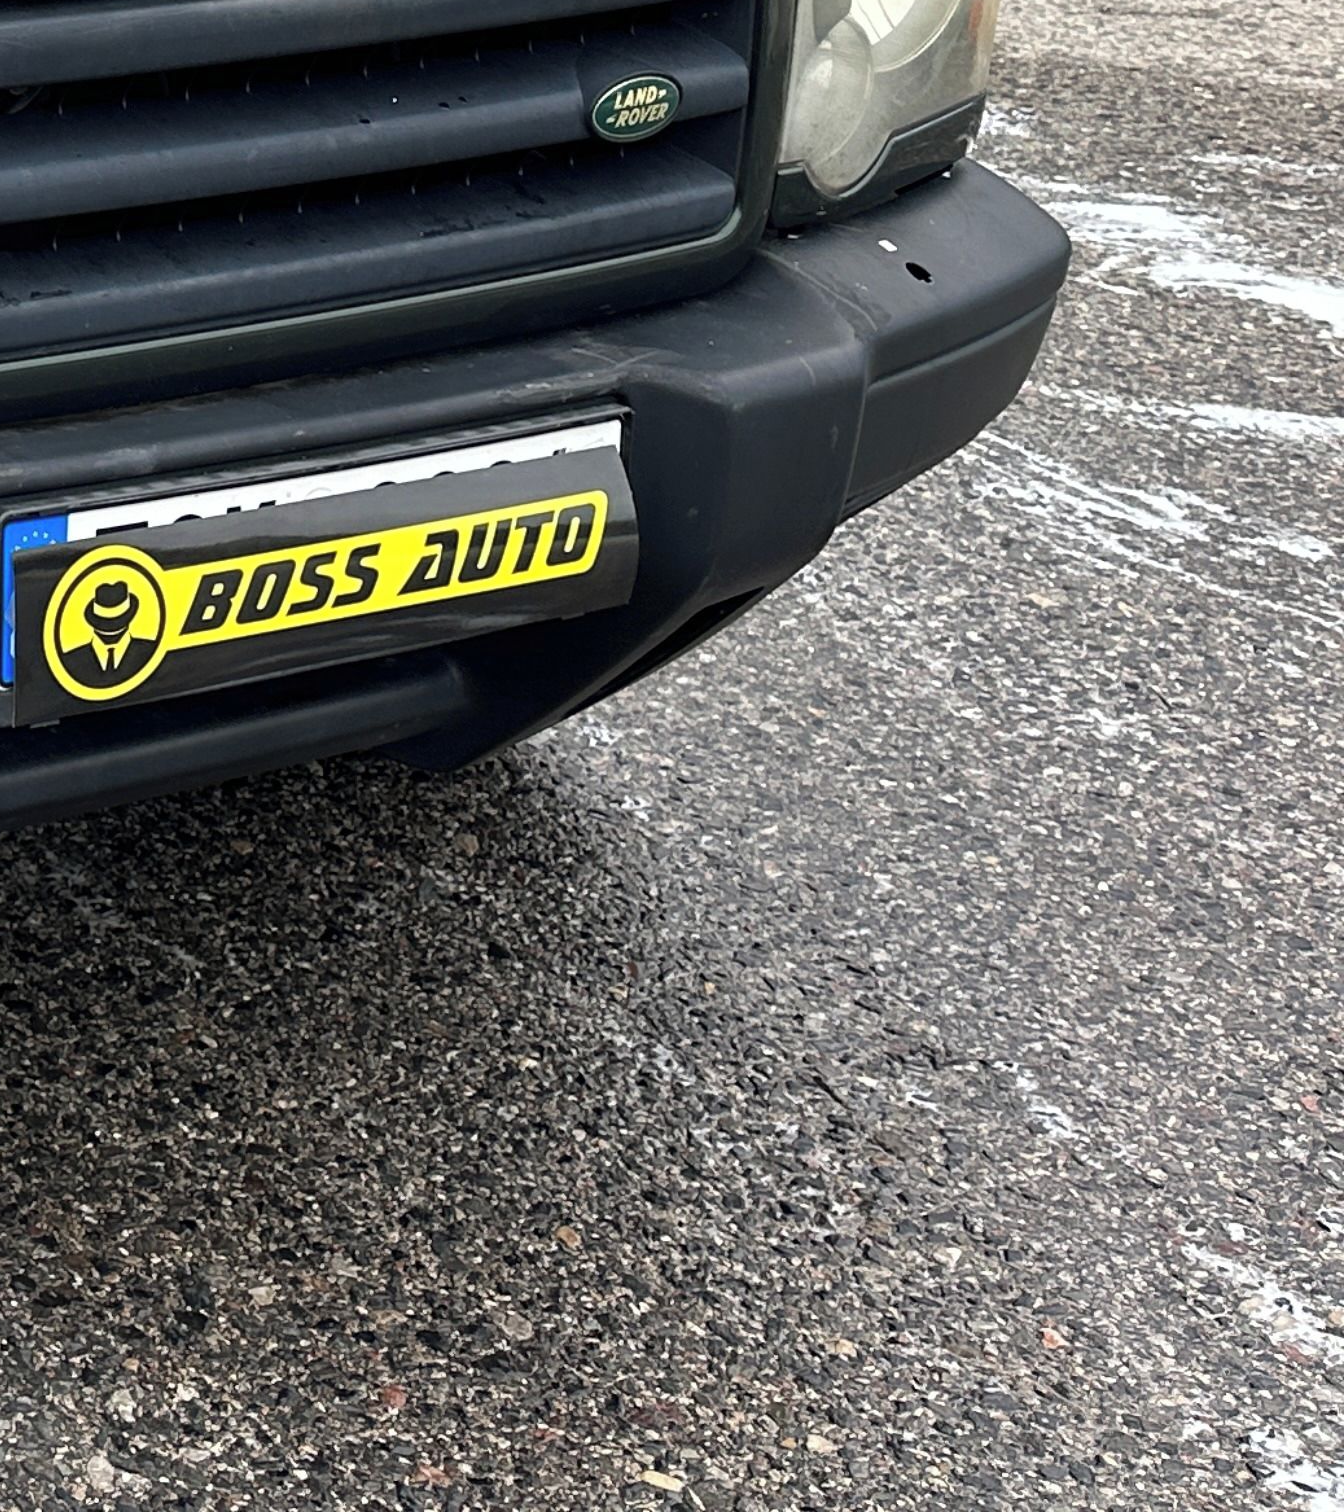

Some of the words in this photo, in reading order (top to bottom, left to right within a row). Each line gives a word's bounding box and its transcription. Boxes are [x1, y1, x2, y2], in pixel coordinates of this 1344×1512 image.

[613, 85, 658, 111] LAND
[614, 101, 670, 129] ROVER
[179, 543, 383, 637] BOSS
[397, 503, 597, 596] AUTO
